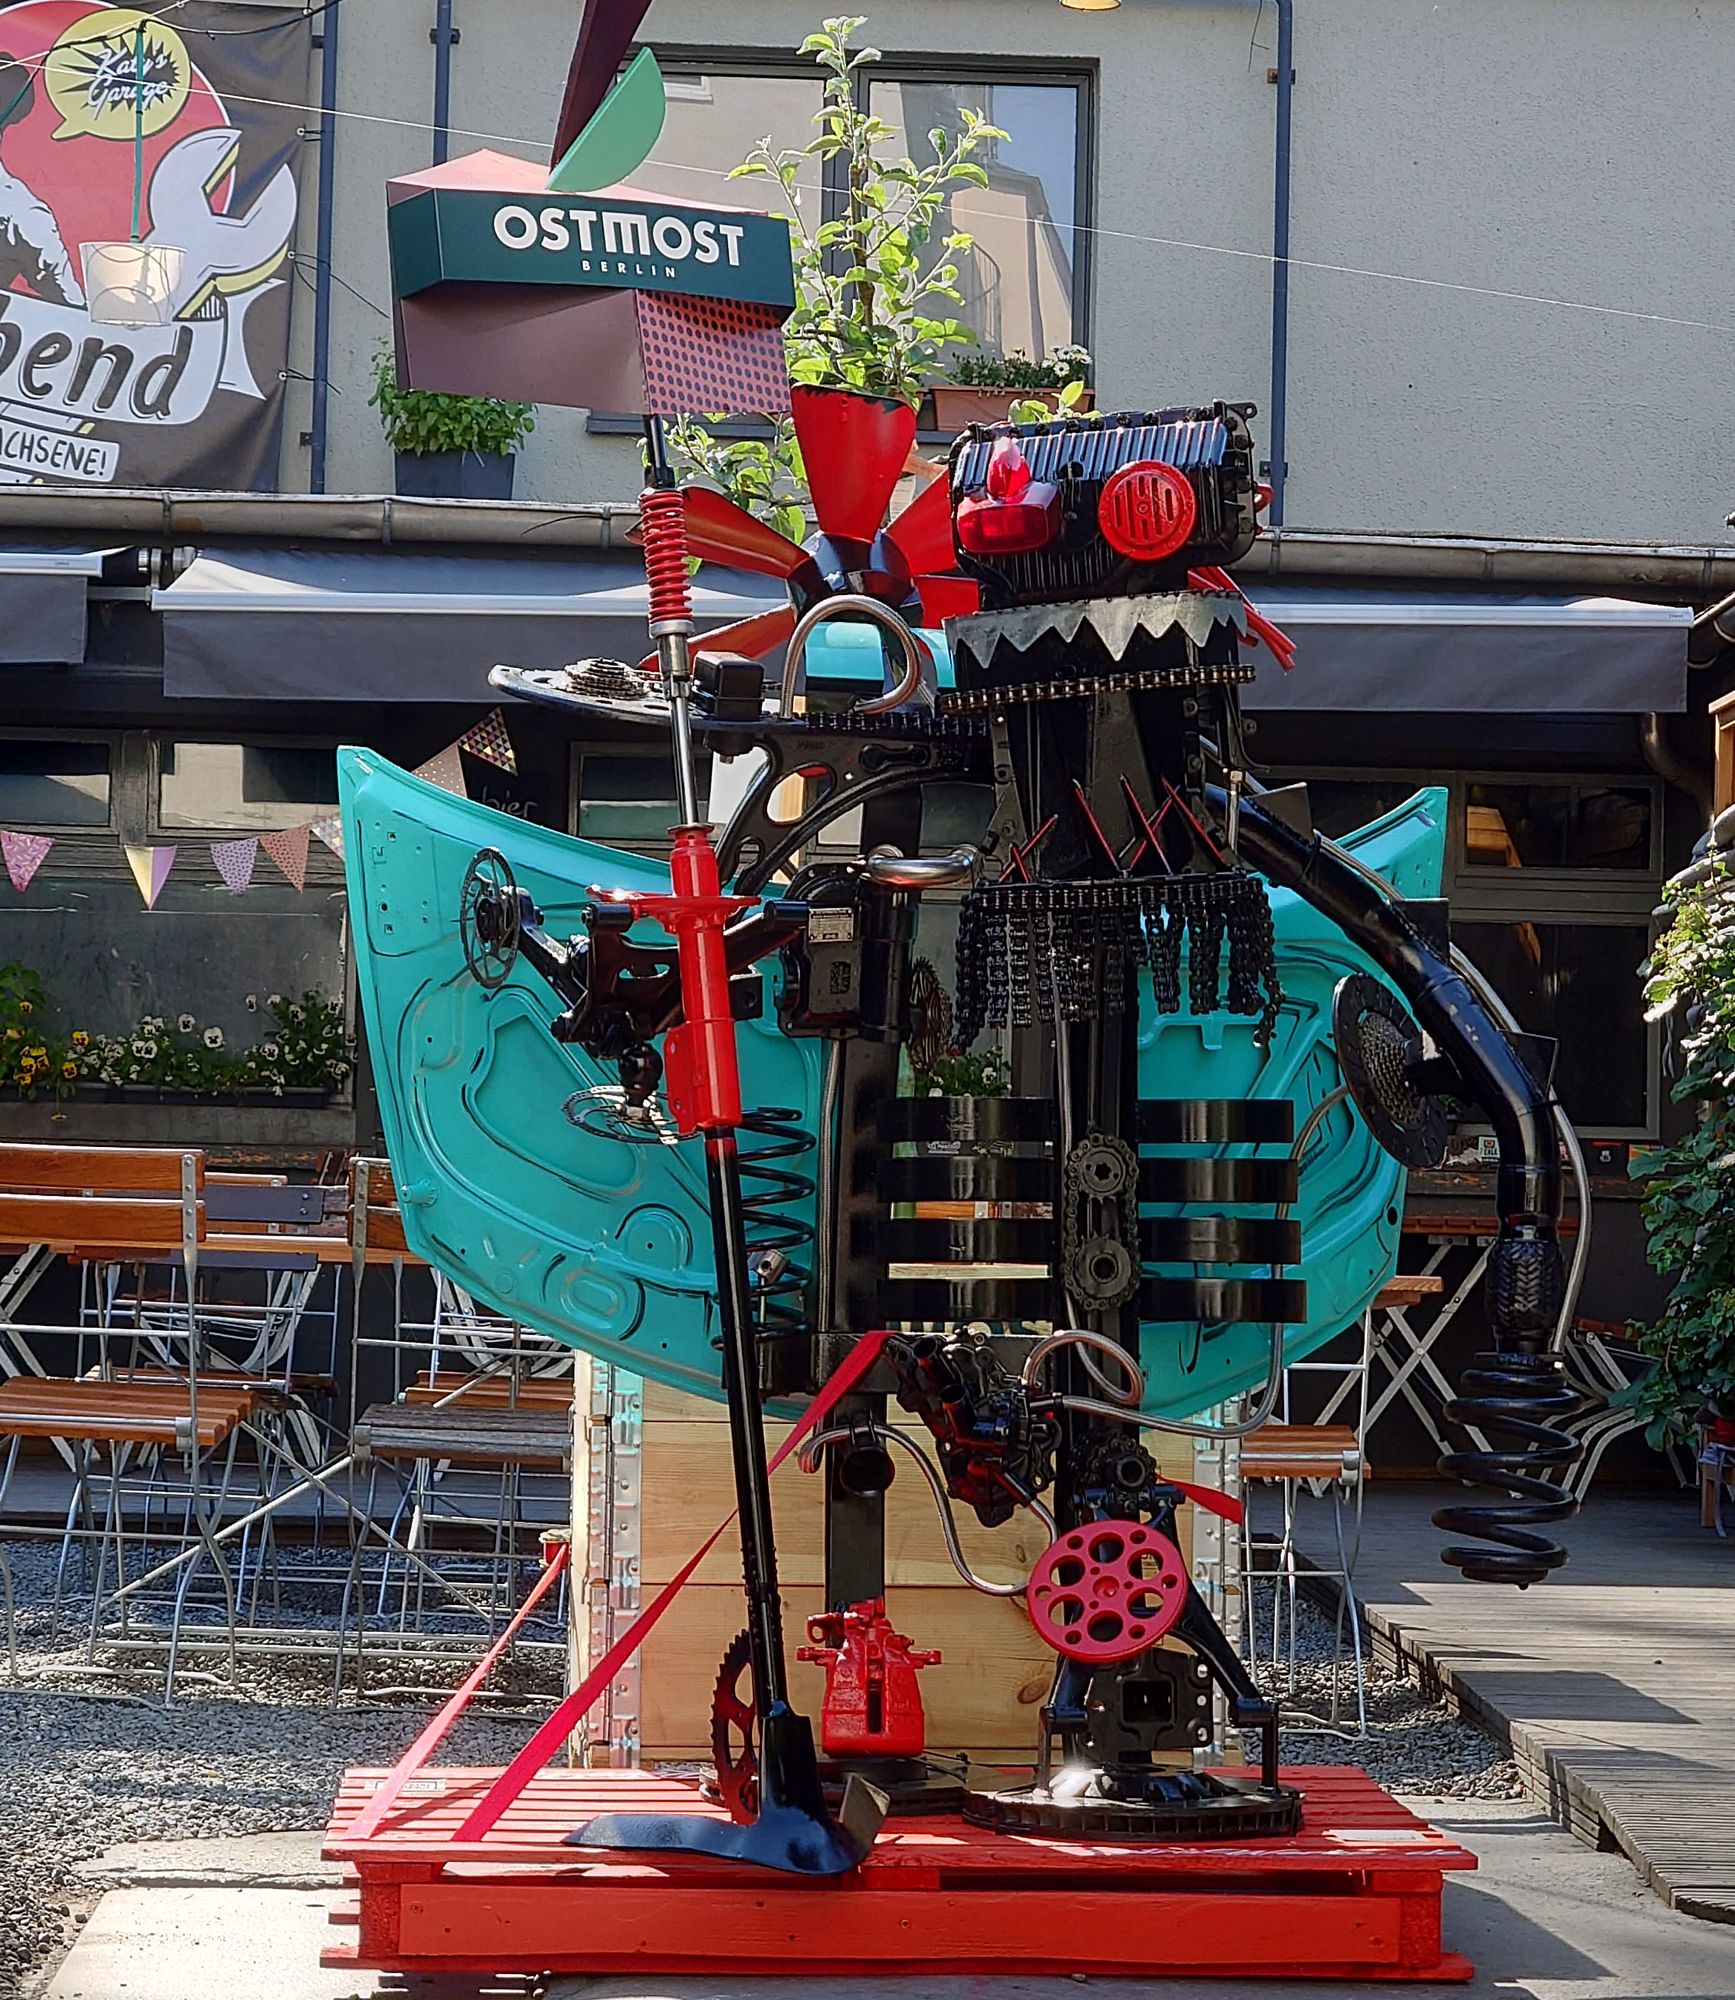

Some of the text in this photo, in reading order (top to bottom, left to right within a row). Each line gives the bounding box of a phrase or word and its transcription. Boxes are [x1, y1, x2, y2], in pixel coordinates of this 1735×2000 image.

[94, 40, 168, 77] Katy's
[493, 205, 744, 266] OSTMOST
[582, 260, 676, 278] BERLIN
